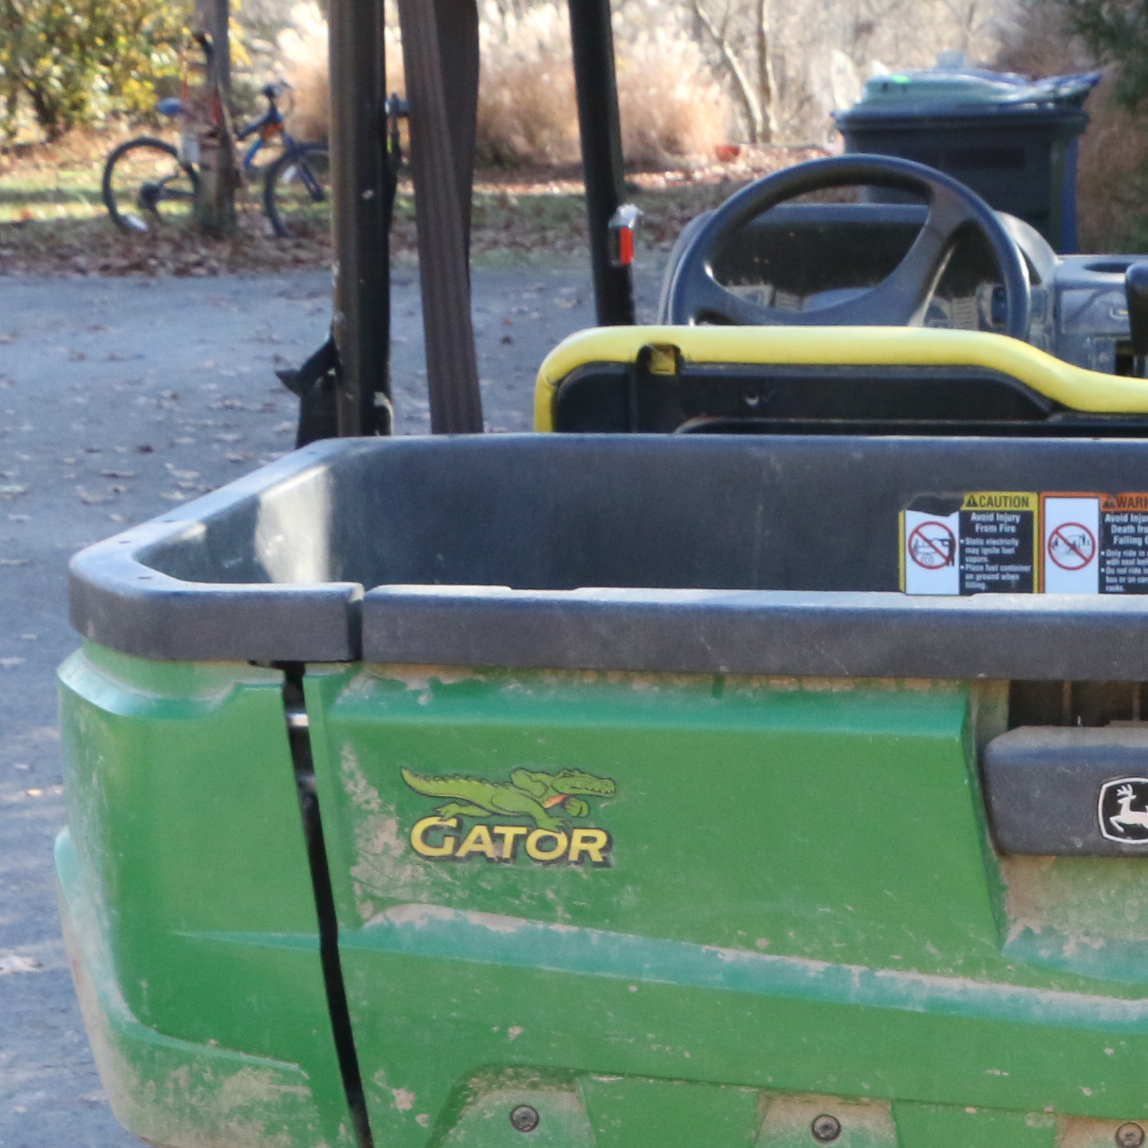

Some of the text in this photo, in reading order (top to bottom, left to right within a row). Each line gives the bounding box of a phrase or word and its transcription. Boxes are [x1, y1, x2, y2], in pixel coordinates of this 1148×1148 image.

[979, 495, 1029, 508] CAUTION
[971, 512, 1021, 524] Avoid Injury
[1104, 513, 1128, 523] Avoid
[975, 523, 1017, 533] From Fire
[1111, 524, 1135, 534] Death
[1113, 535, 1142, 547] Falling
[1105, 549, 1121, 558] Only
[1122, 549, 1137, 557] ride
[410, 815, 609, 864] GATOR
